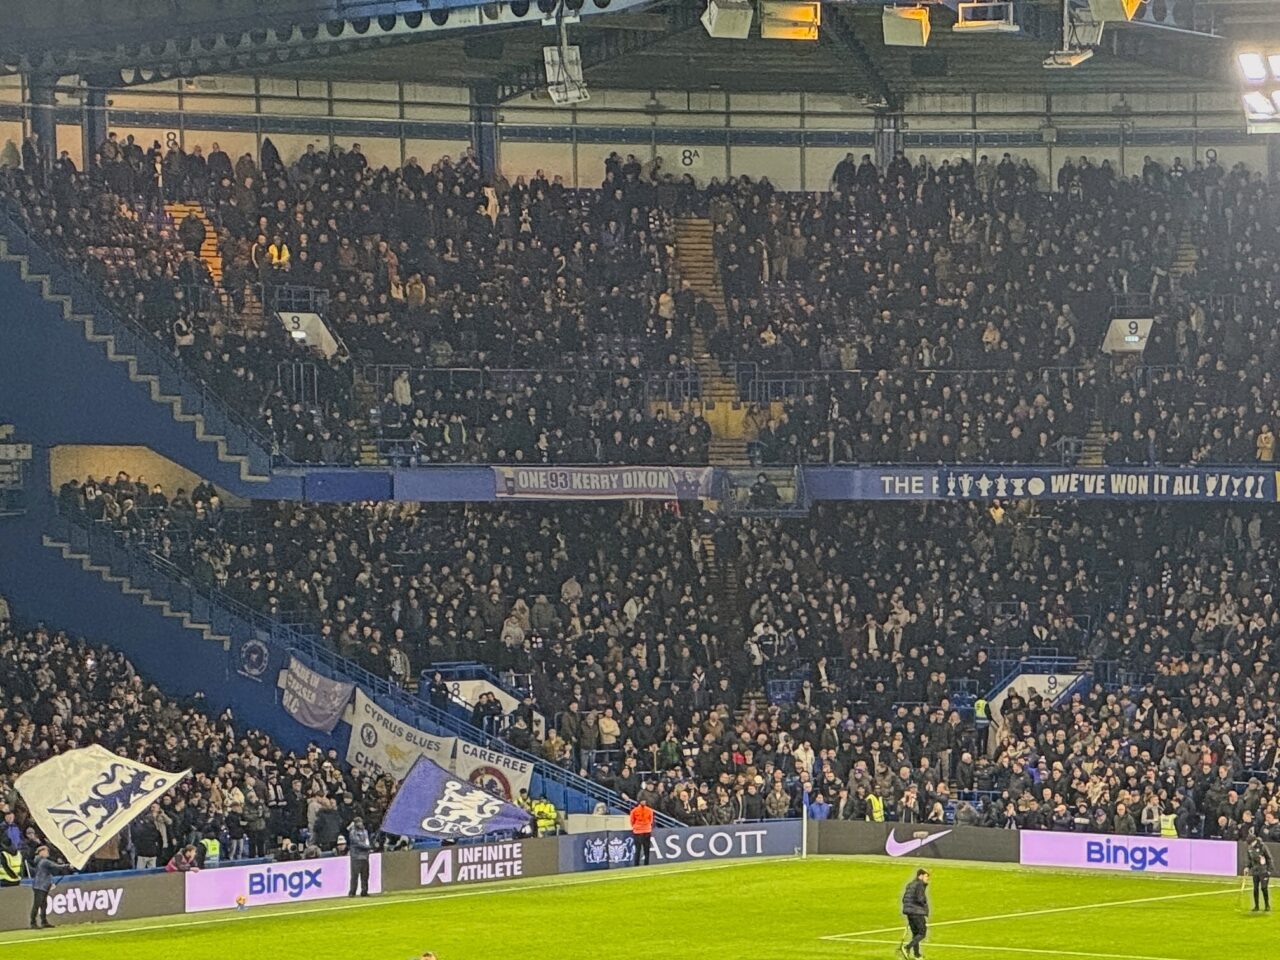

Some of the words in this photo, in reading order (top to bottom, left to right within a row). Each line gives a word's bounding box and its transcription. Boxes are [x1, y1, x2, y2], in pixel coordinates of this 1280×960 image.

[1128, 321, 1139, 335] 9
[518, 471, 547, 489] ONE
[550, 471, 570, 490] 93
[572, 472, 618, 489] KERRY
[622, 469, 669, 489] DIXON
[880, 476, 924, 494] THE
[1051, 473, 1106, 494] WE'VE
[1110, 473, 1149, 495] WON
[1153, 474, 1170, 494] IT
[1172, 474, 1200, 496] ALL
[452, 682, 460, 697] 8
[1047, 675, 1057, 690] 9
[364, 703, 405, 738] CYPRUS
[405, 731, 441, 752] BLUES
[462, 743, 528, 774] CAREFREE
[457, 843, 523, 864] INFINITE
[457, 860, 523, 882] ATHLETE
